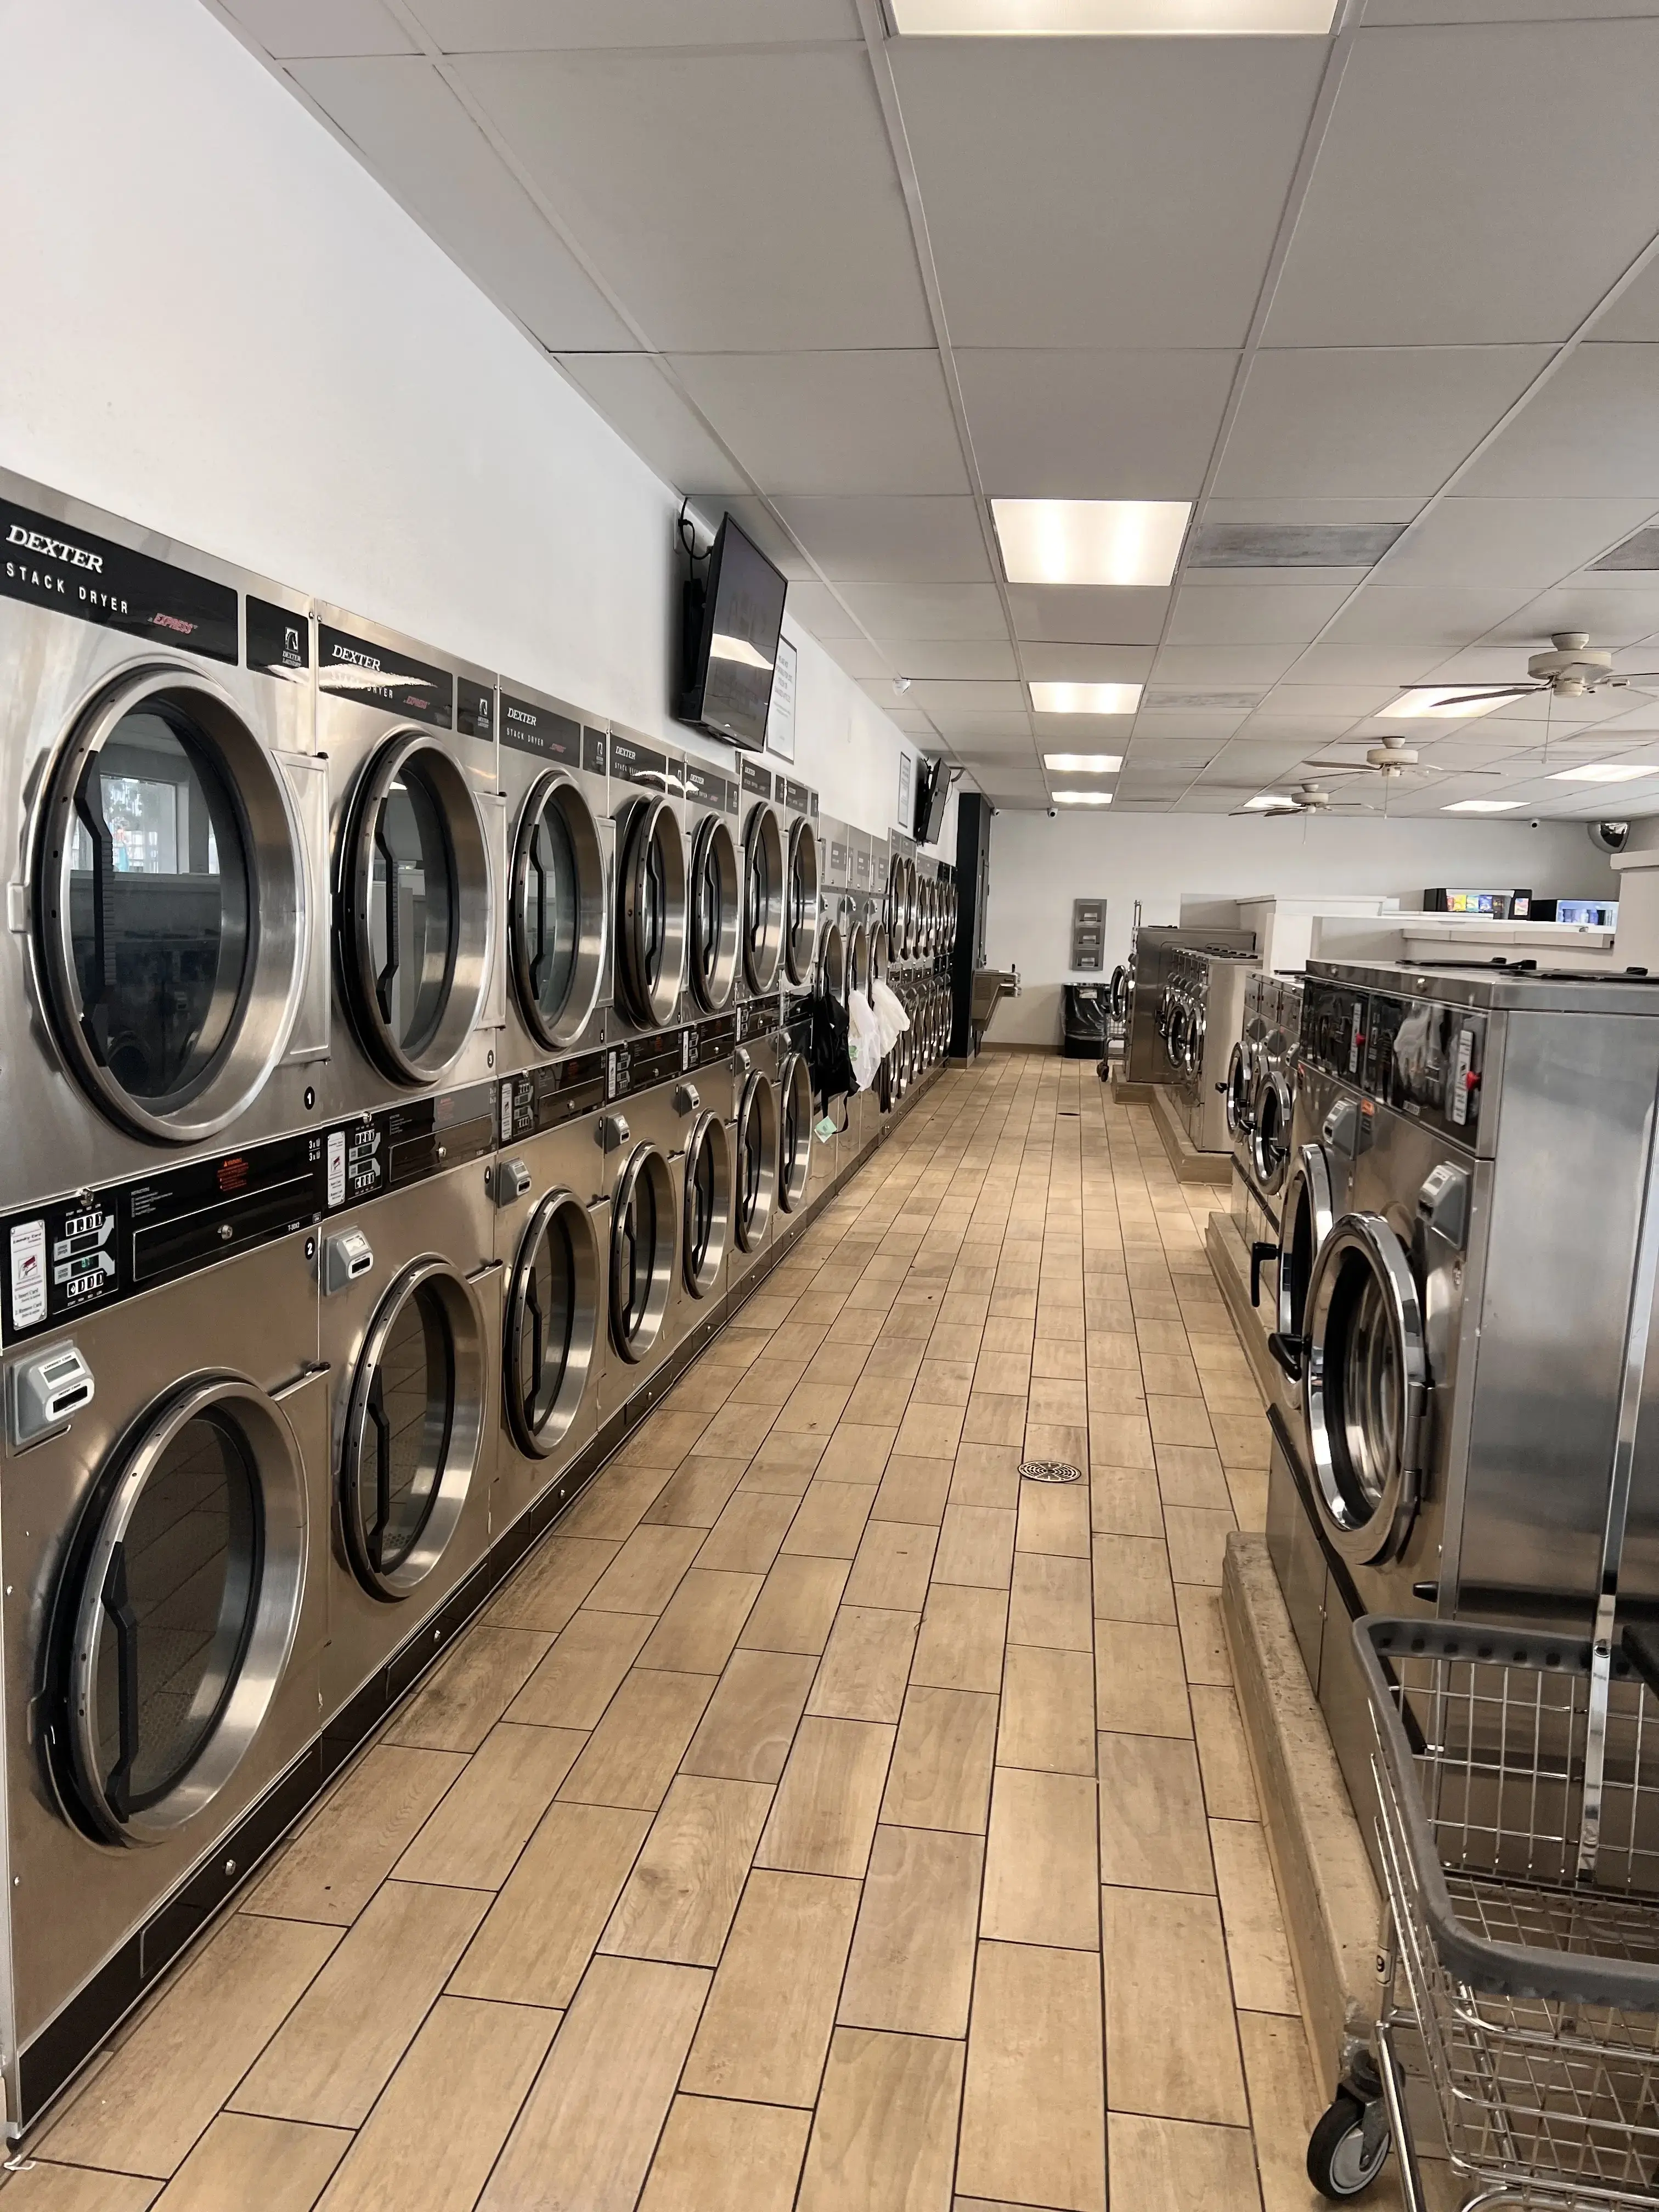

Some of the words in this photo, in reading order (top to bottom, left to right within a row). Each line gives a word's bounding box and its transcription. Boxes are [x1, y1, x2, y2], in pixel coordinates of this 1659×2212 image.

[6, 524, 103, 573] DEXTER
[6, 562, 65, 594] STACK
[78, 586, 128, 614] DRYER
[332, 644, 381, 672] DEXTER
[507, 707, 537, 726] DEXTER
[506, 727, 524, 741] STACK
[615, 746, 636, 760] DEXTER
[307, 1092, 312, 1105] 1
[307, 1242, 313, 1255] 2
